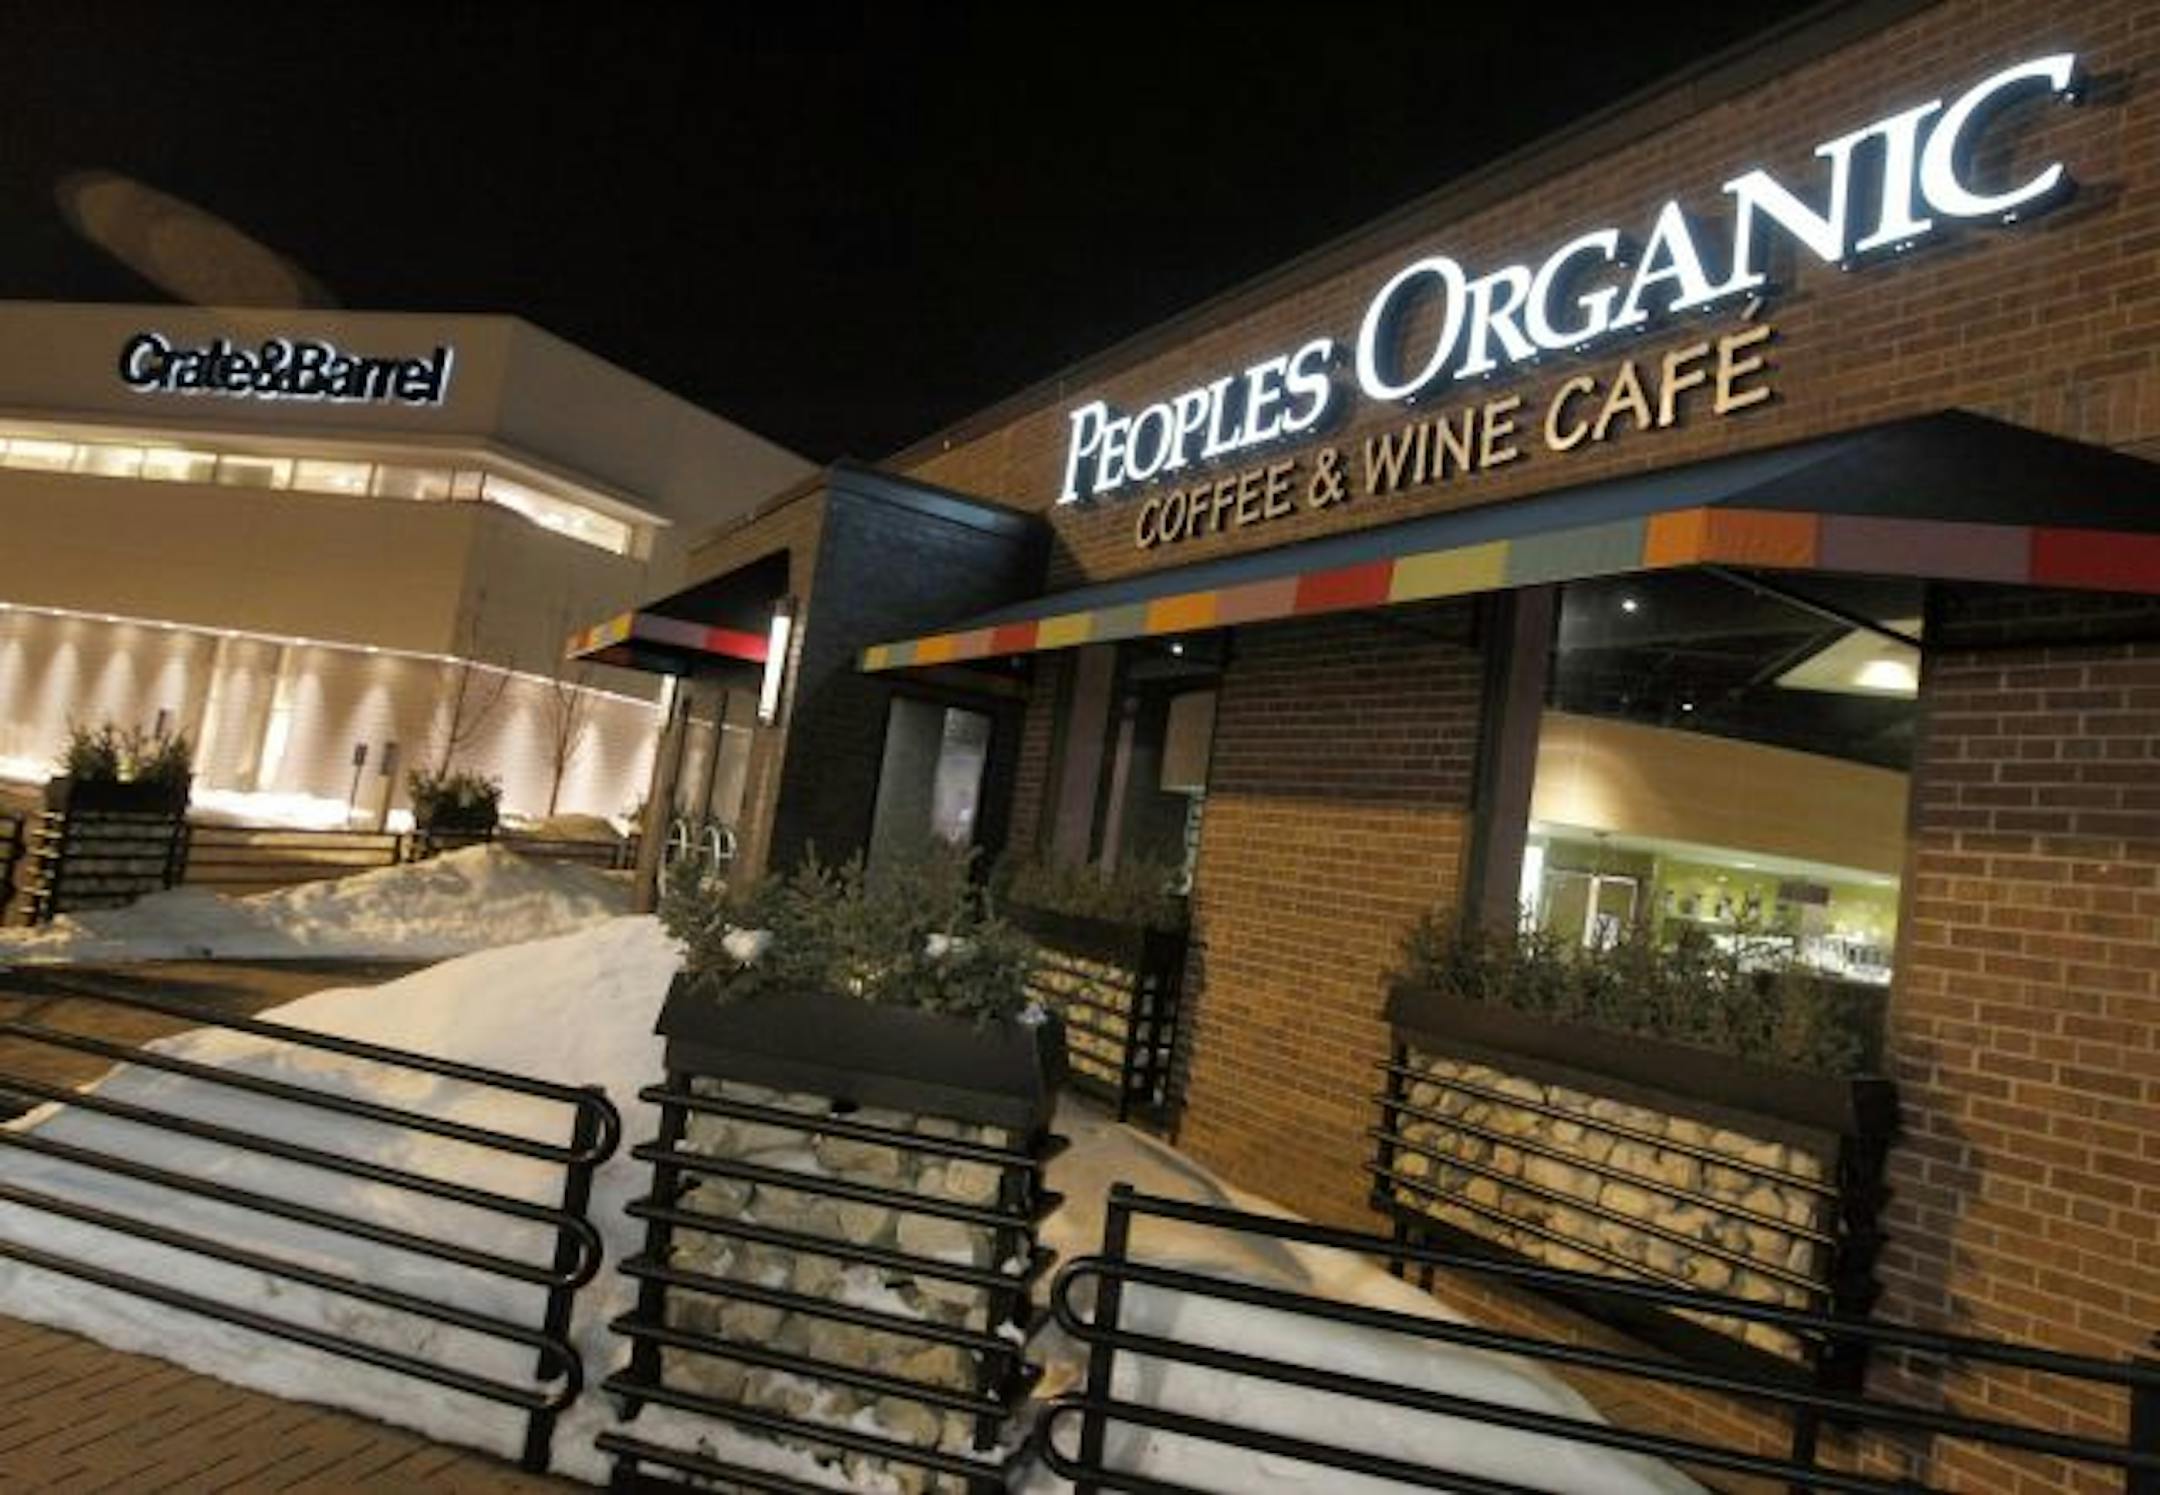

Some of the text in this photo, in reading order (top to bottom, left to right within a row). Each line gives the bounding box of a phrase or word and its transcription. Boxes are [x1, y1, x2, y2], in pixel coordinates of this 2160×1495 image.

[119, 332, 454, 407] Crate&Barrel
[1056, 53, 2076, 505] PEOPLES ORGANIC
[1134, 297, 1771, 548] COFFEE & WINE CAFÉ
